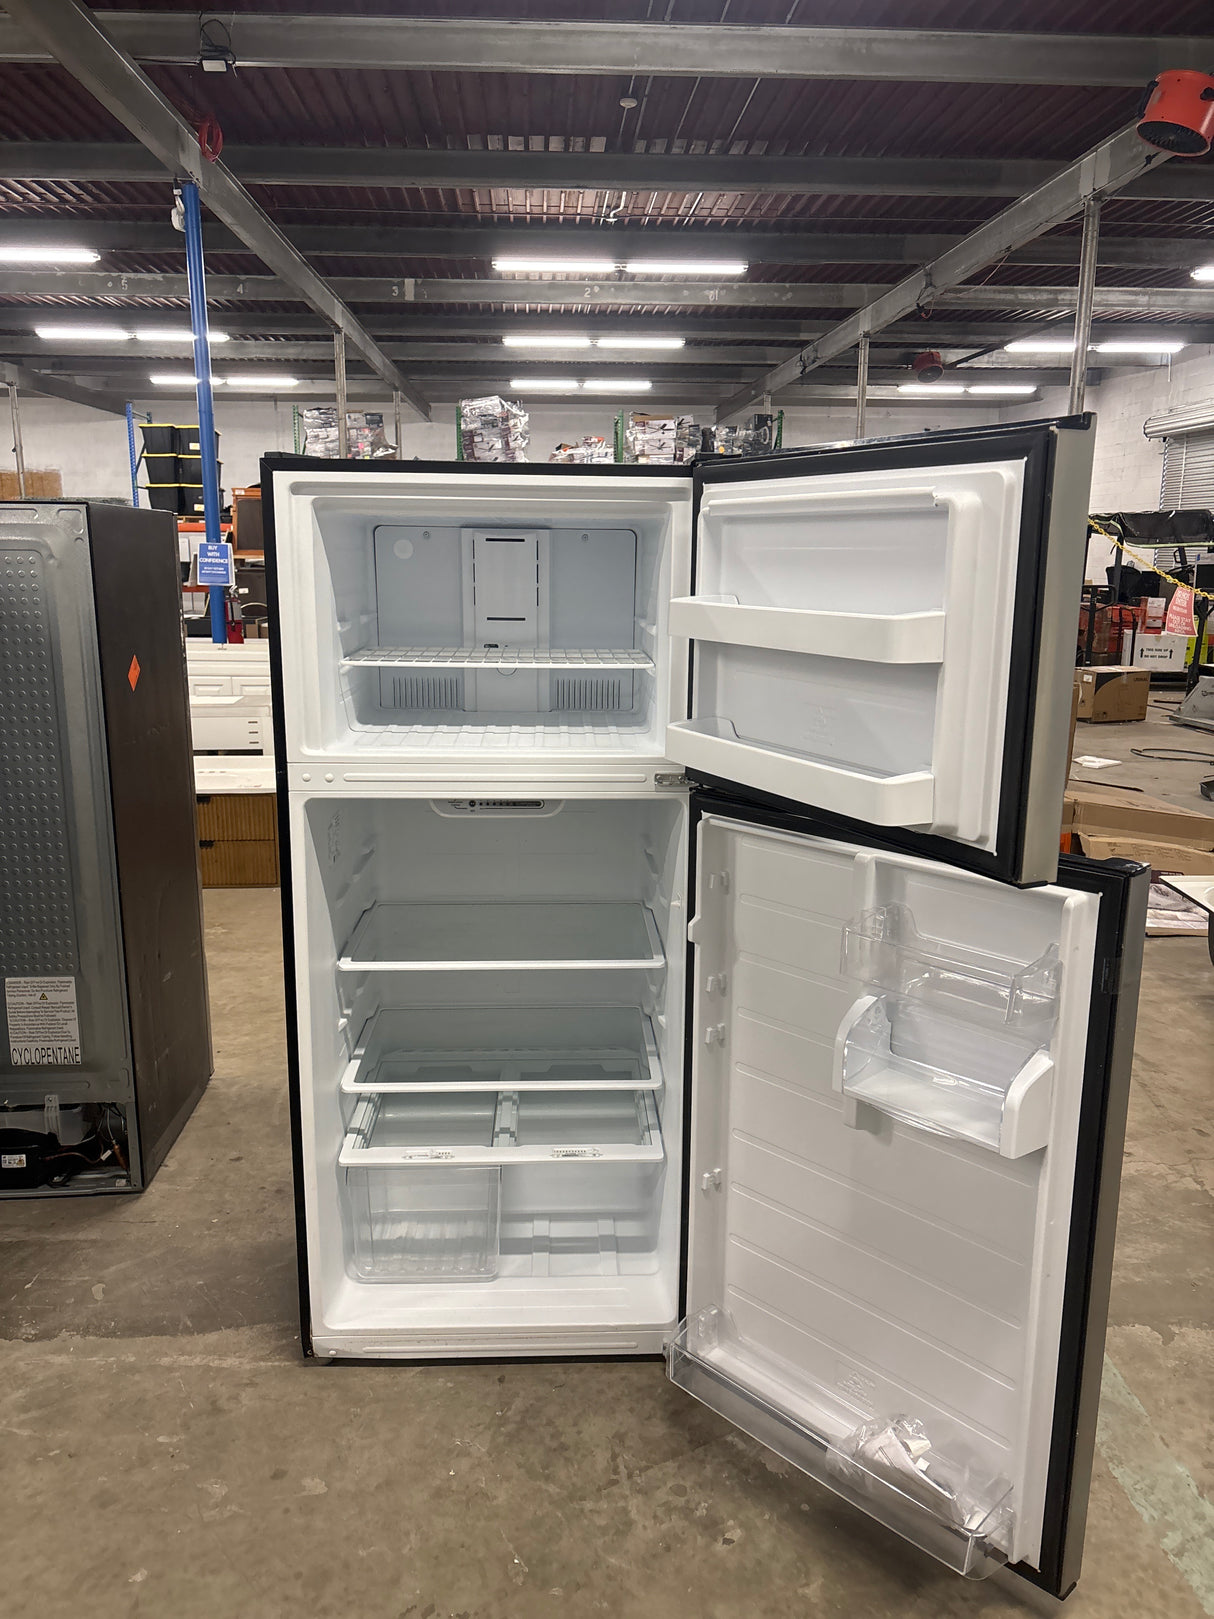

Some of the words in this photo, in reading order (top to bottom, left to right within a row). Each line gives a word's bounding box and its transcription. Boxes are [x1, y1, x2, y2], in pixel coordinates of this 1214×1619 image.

[236, 283, 243, 294] 4
[391, 285, 399, 296] 3
[584, 287, 591, 297] 2
[11, 1047, 80, 1065] CYCLOPENTANE
